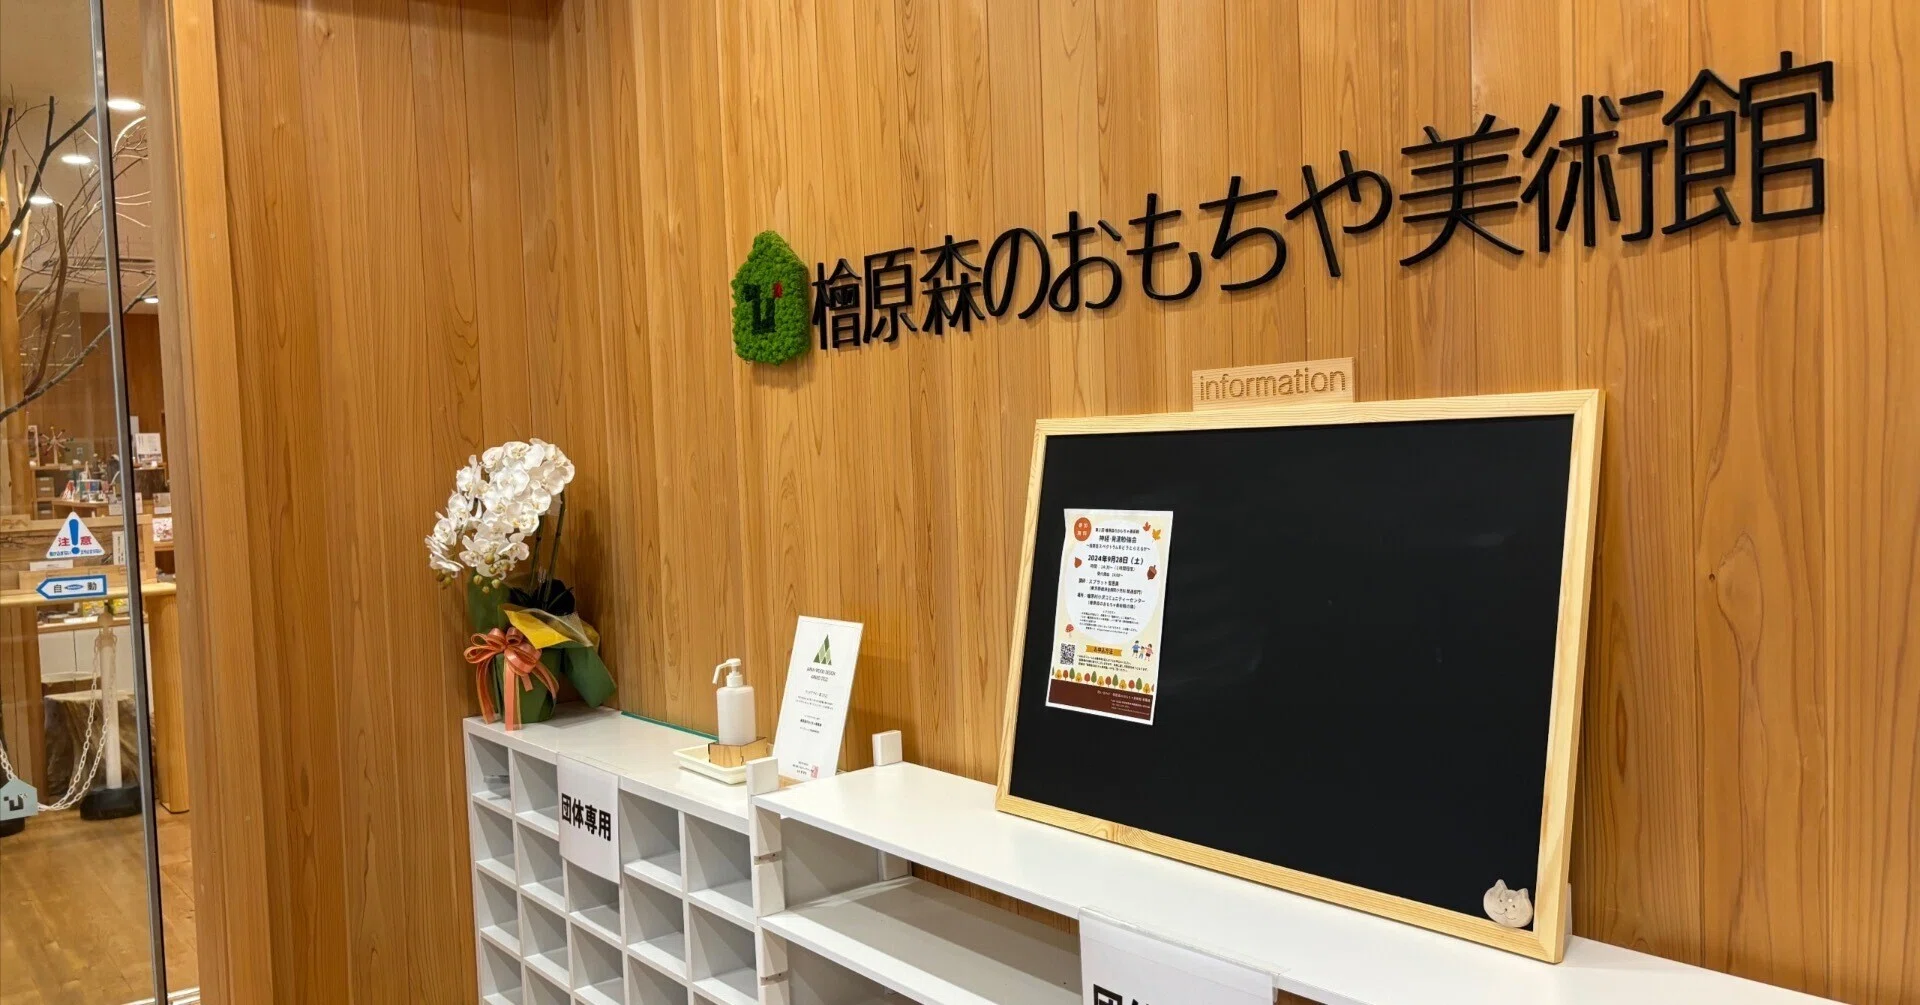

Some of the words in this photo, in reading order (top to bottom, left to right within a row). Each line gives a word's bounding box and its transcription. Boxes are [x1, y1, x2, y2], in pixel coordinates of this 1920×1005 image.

[1200, 367, 1346, 400] information
[561, 793, 612, 841] 団体専用
